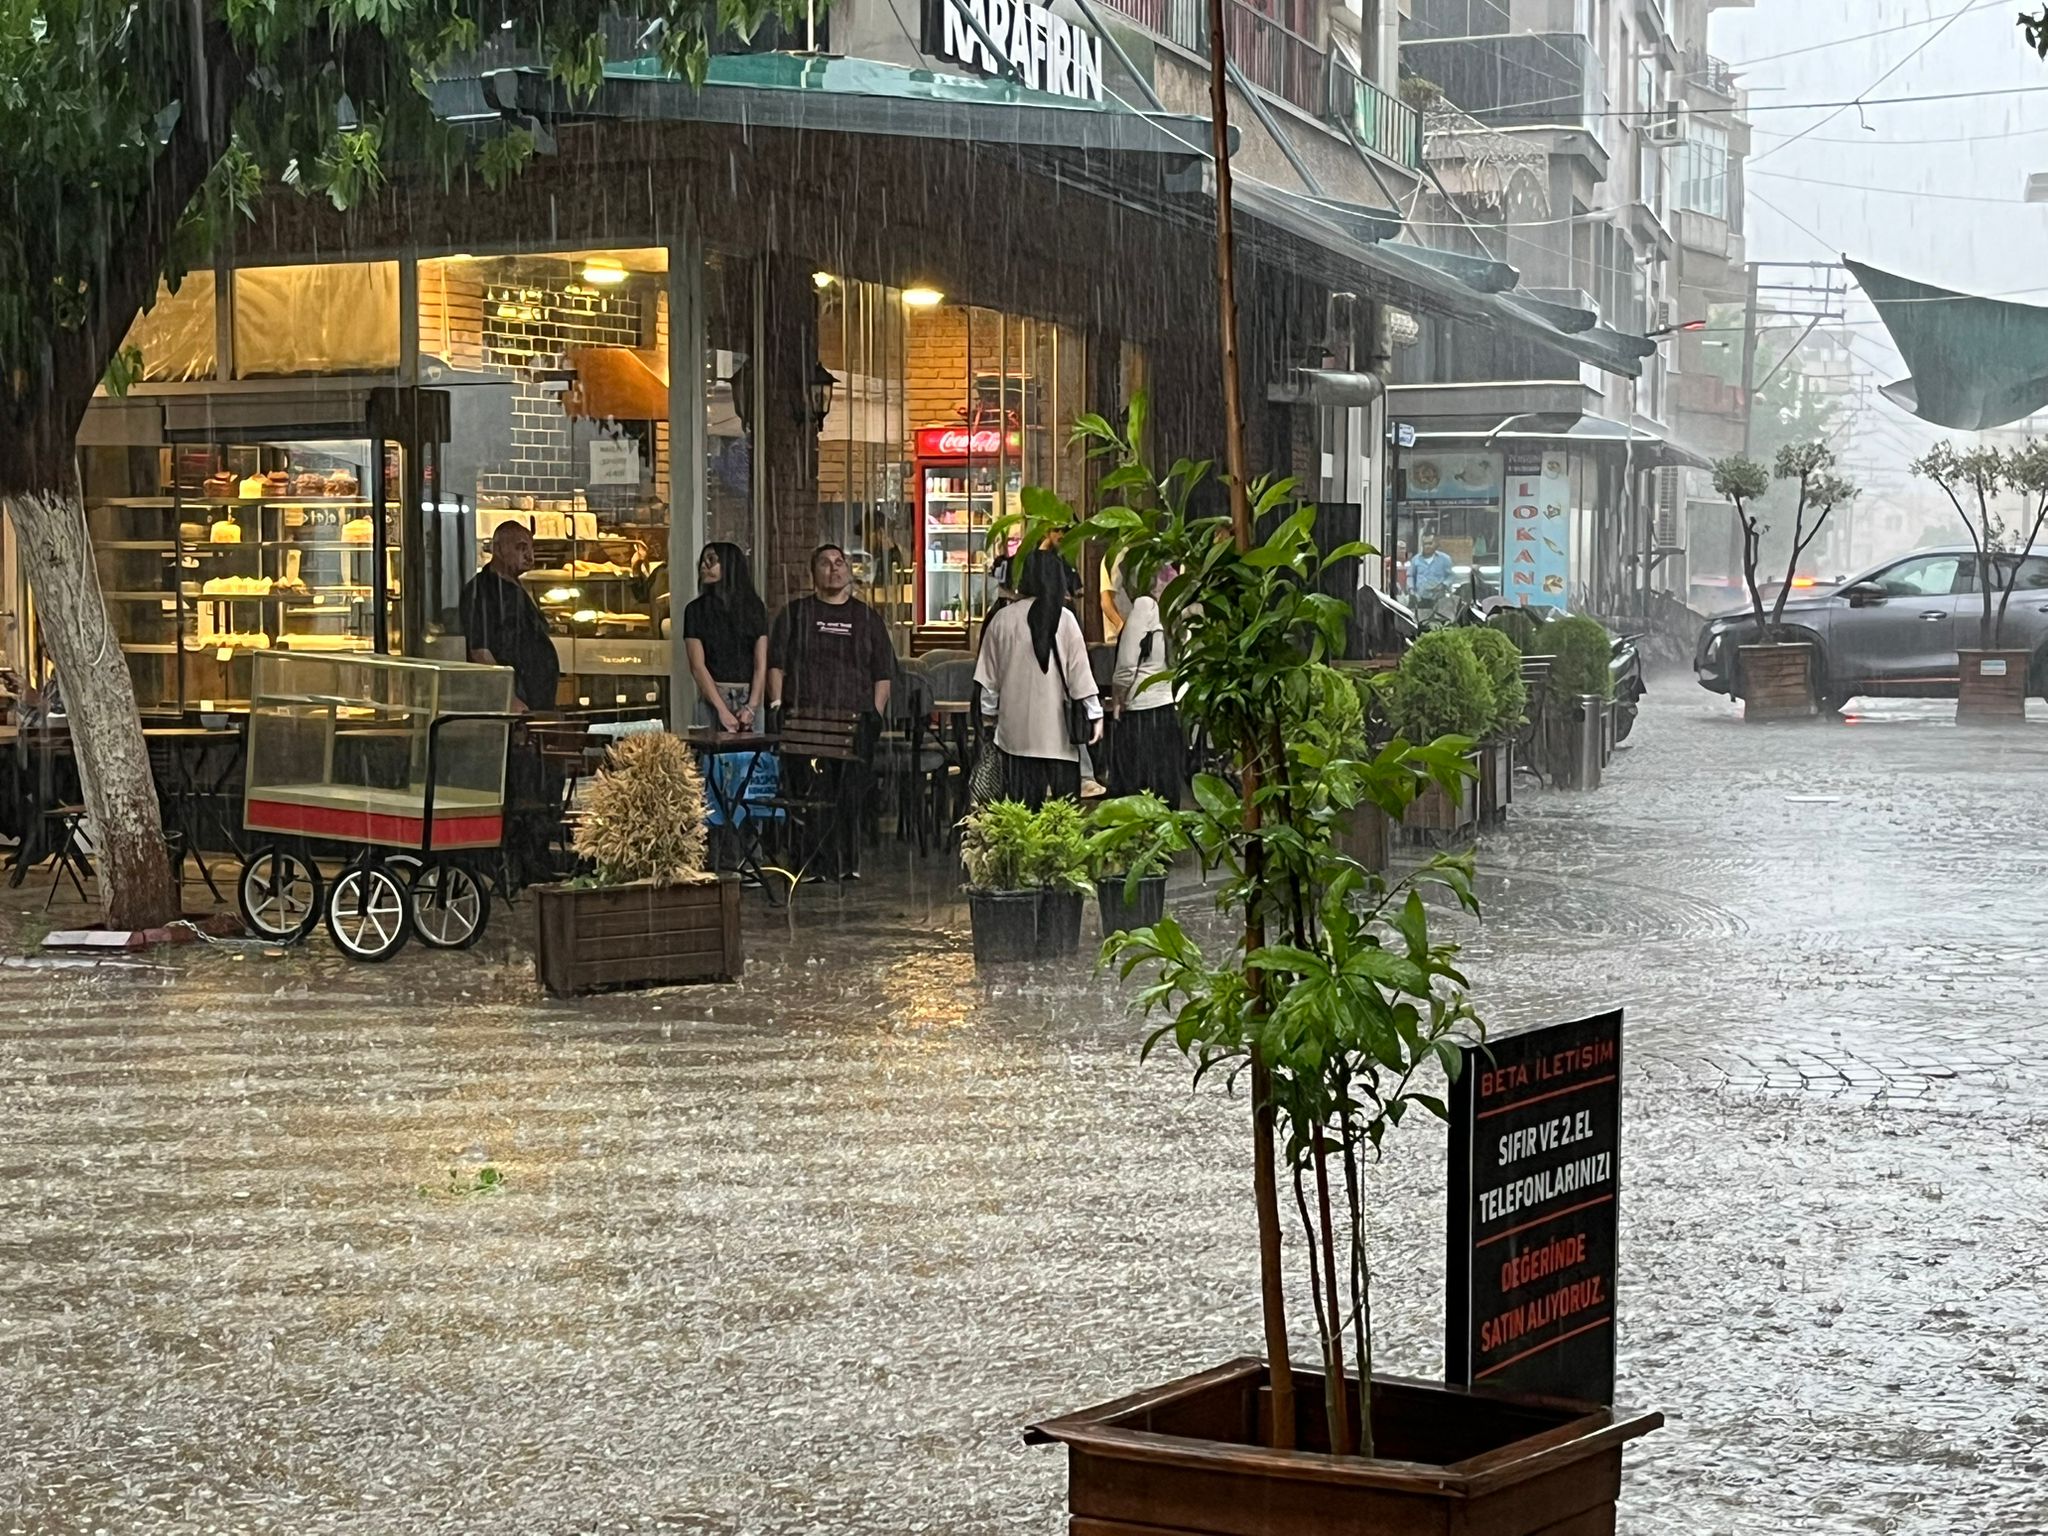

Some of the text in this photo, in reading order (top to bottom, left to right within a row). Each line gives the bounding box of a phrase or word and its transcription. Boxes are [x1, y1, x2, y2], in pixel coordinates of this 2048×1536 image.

[1511, 482, 1540, 608] LOKANT
[1481, 1065, 1528, 1097] BETA
[1498, 1109, 1594, 1166] SIFIR VE 2.EL
[1479, 1151, 1611, 1224] TELEFONLARINIZI
[1501, 1232, 1587, 1292] DEĞERİNDE
[1481, 1275, 1605, 1352] SATIN ALIYORUZ.
